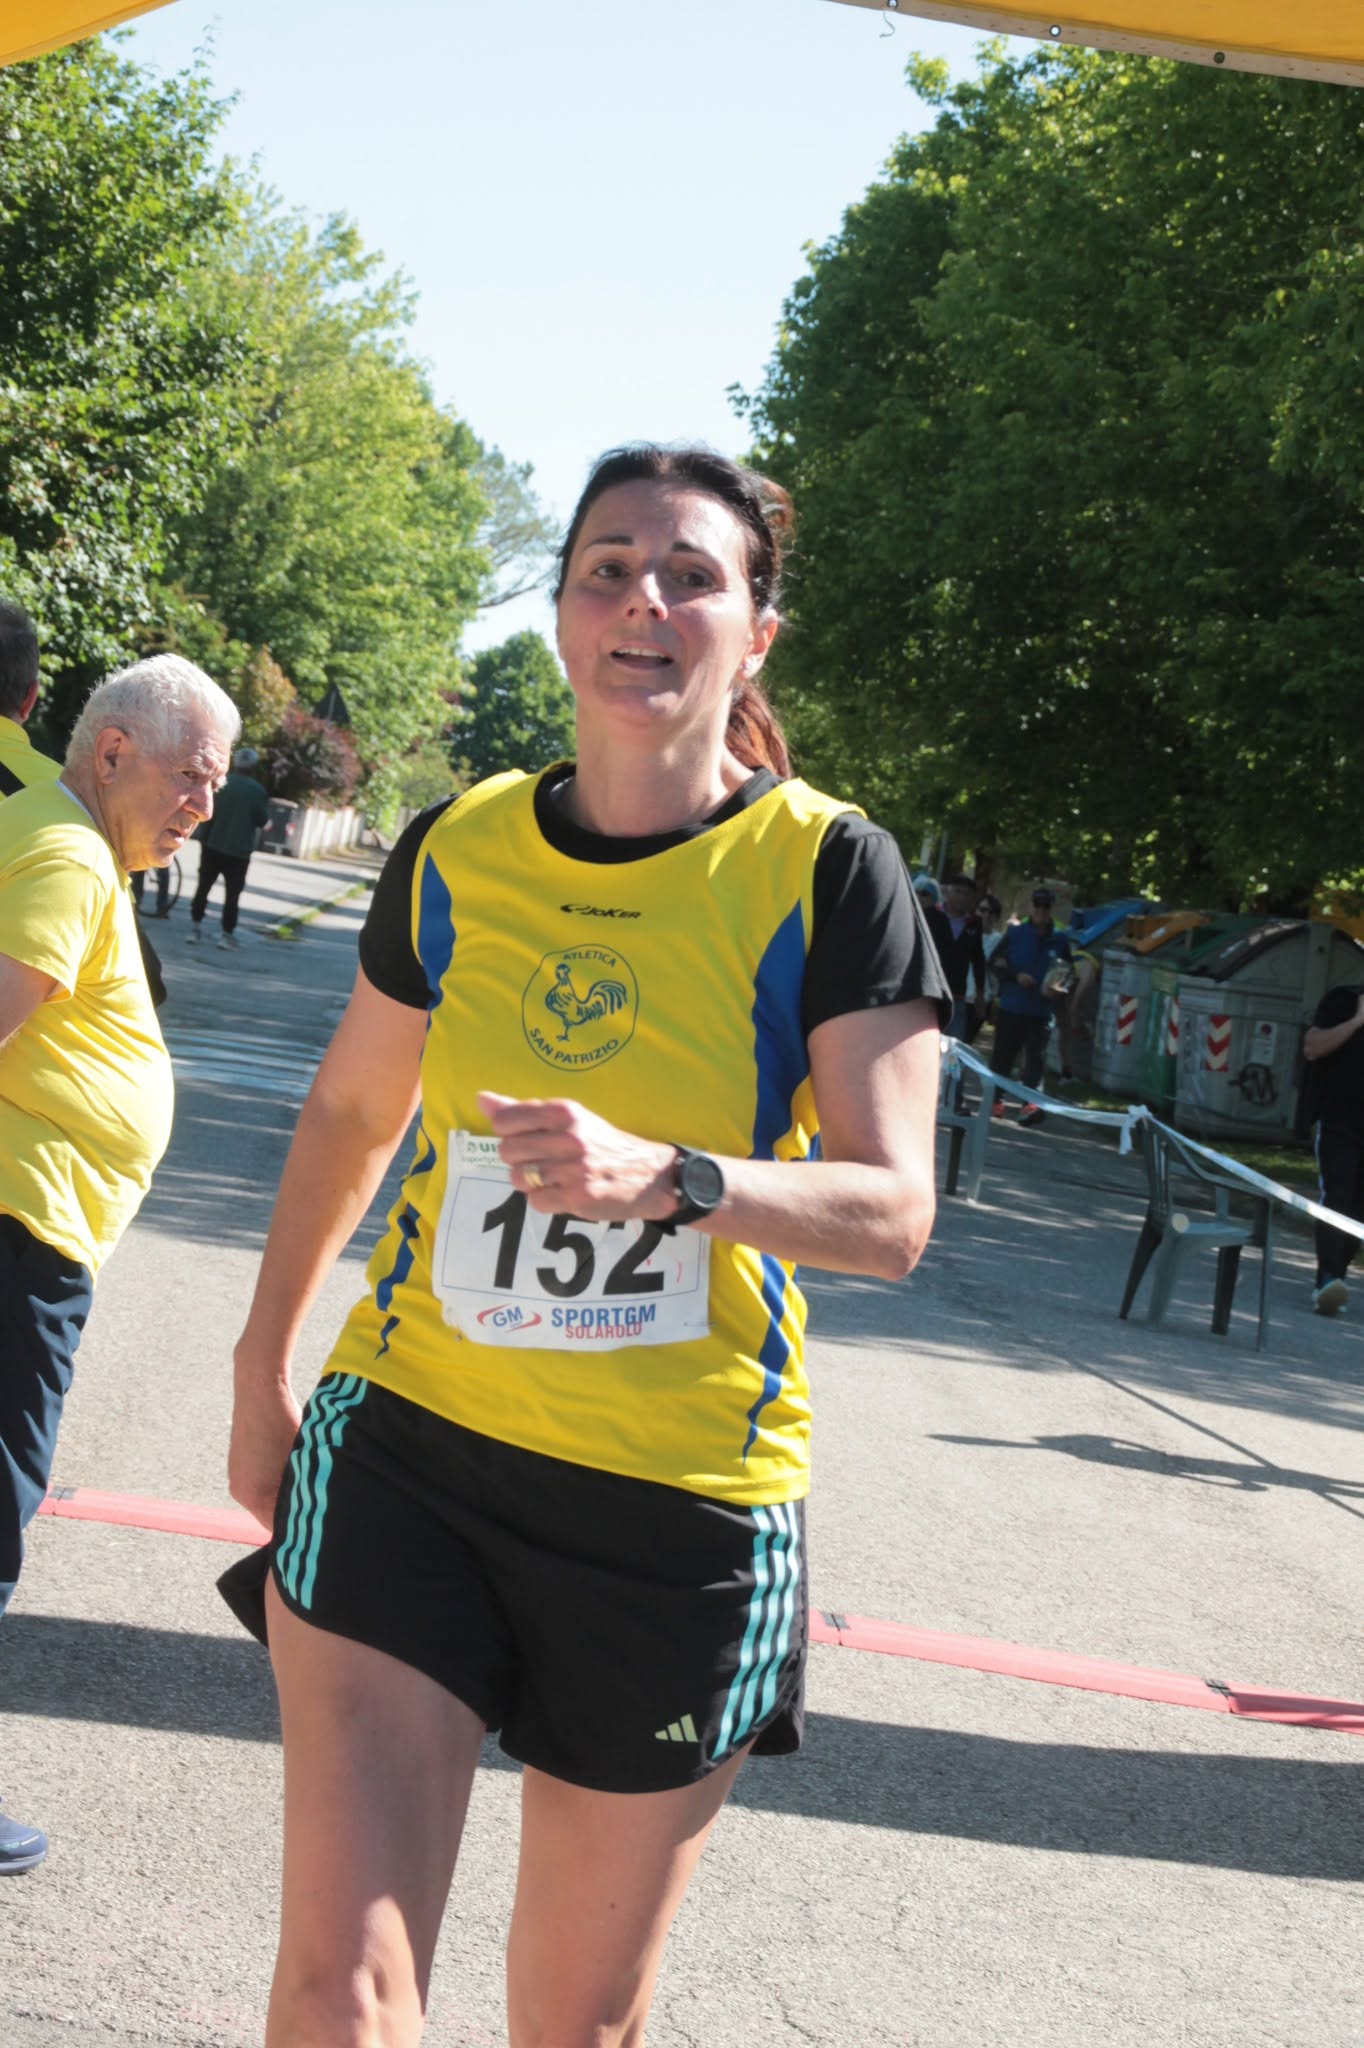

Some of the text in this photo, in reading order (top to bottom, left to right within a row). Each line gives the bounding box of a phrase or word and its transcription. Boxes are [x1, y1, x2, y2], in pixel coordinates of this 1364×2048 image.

[563, 950, 617, 968] ATLETICA
[530, 1028, 619, 1064] SAN PATRIZIO
[482, 1190, 665, 1298] 152
[492, 1303, 656, 1329] GM SPORTGM
